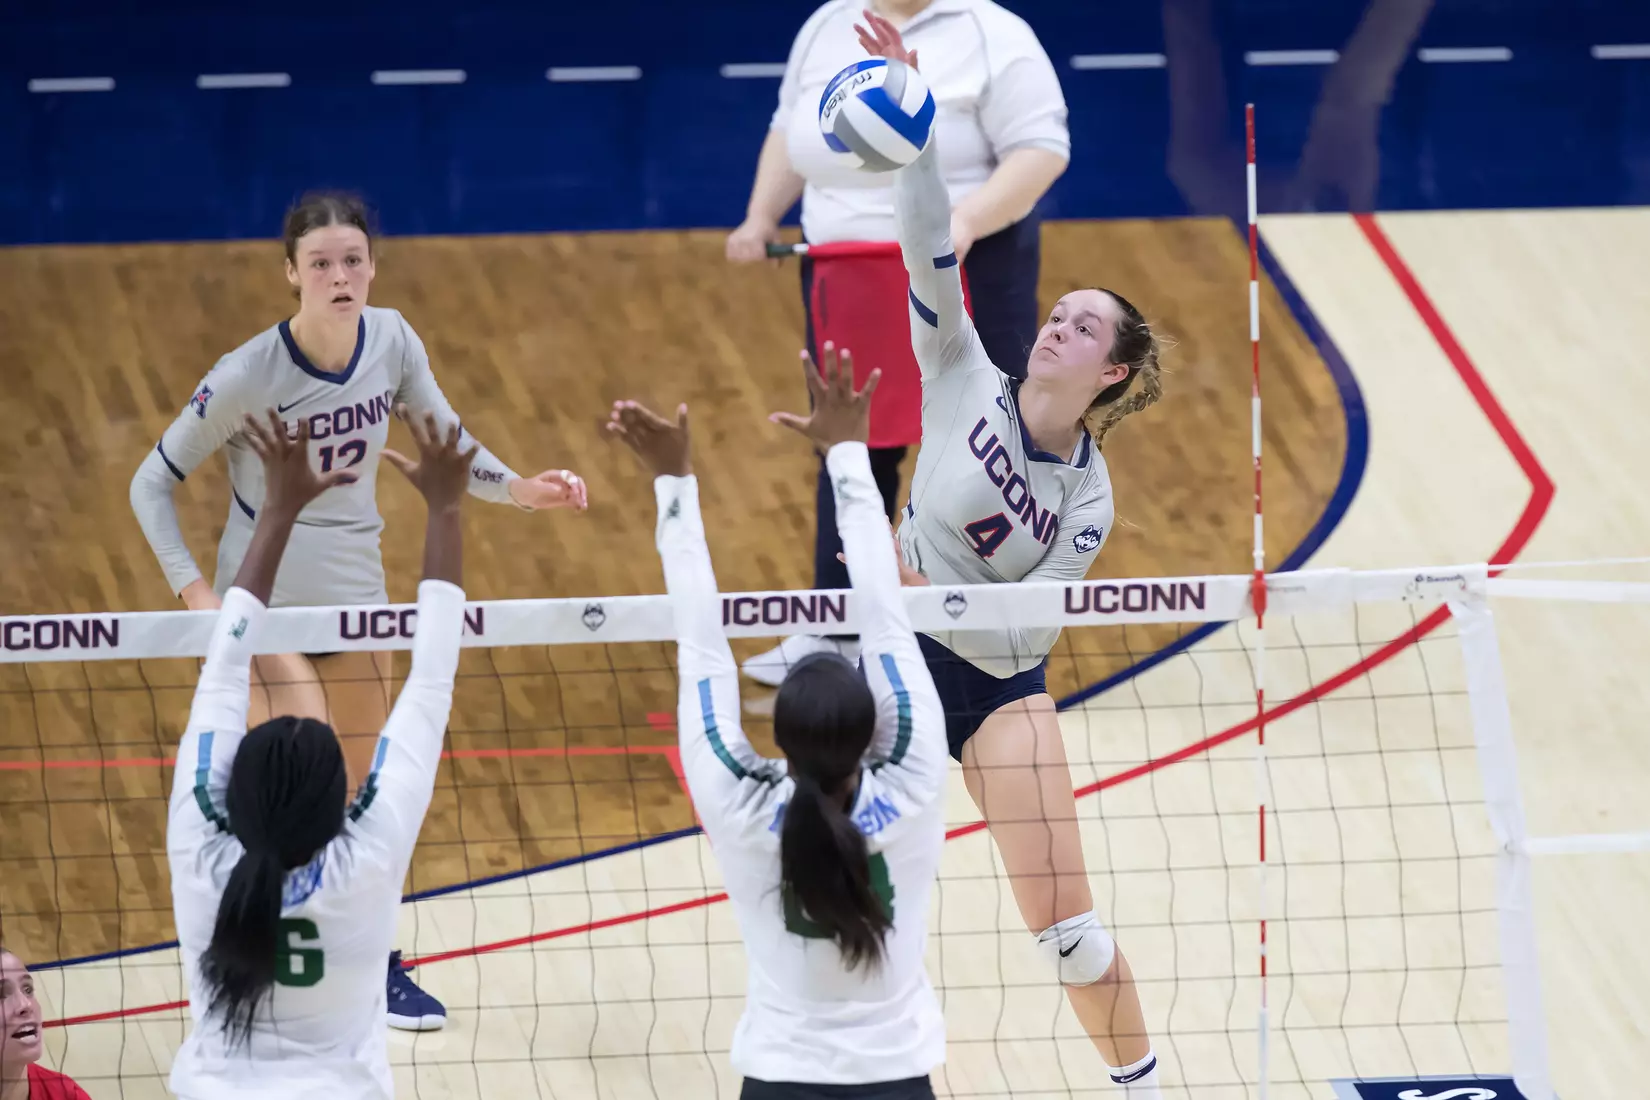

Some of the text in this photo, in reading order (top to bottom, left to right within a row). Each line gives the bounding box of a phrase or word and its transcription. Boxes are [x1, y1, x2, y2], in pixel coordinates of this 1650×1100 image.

[823, 71, 872, 119] mlten
[318, 438, 368, 486] 12
[963, 511, 1014, 559] 4
[0, 618, 120, 652] CONN
[340, 606, 484, 641] UCON
[1064, 582, 1206, 615] UCONN
[274, 918, 325, 988] 6
